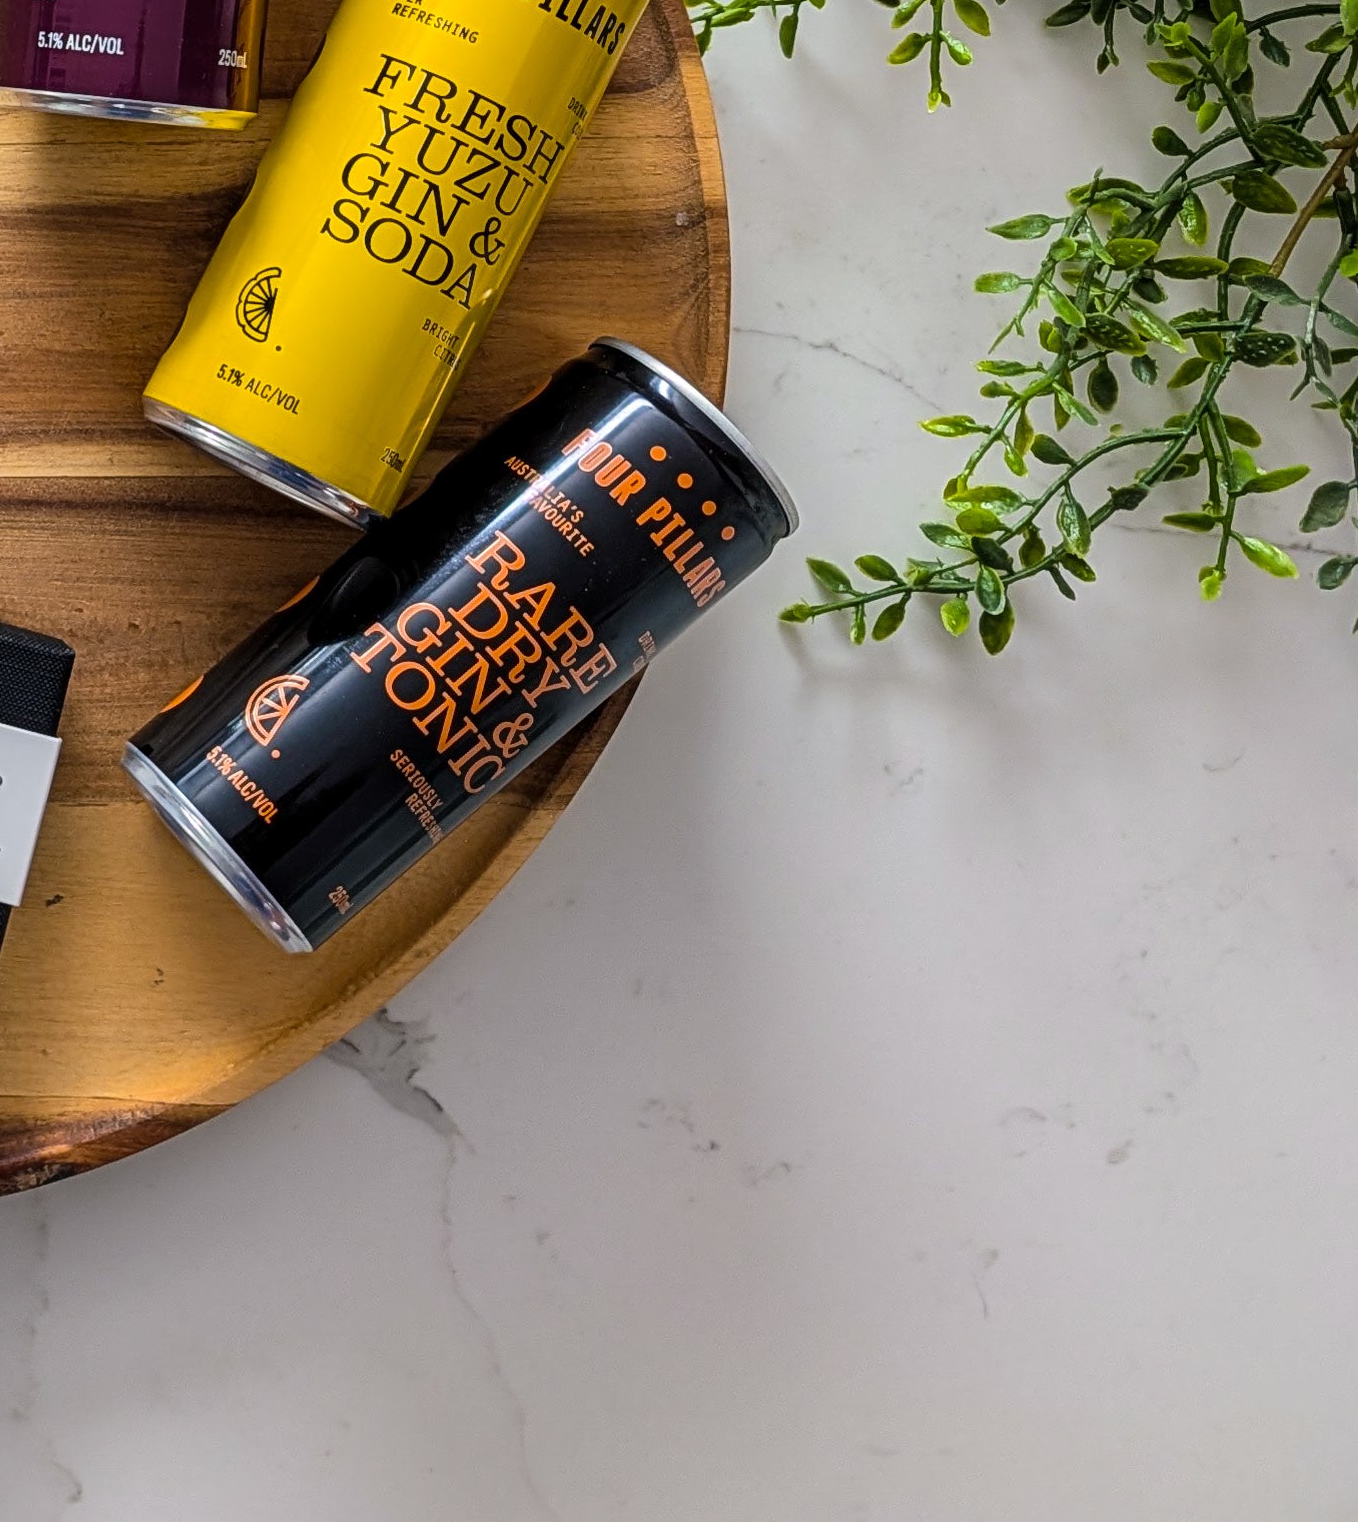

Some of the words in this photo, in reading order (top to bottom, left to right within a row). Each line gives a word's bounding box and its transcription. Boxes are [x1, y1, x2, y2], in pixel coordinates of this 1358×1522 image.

[38, 31, 63, 49] 5.1%
[66, 33, 125, 55] ALC/VOL
[392, 3, 479, 44] REFRESHING
[363, 54, 564, 184] FRESH
[370, 105, 533, 216] YUZU
[320, 199, 477, 309] SODA
[342, 153, 470, 237] GIN
[469, 217, 505, 266] &
[422, 318, 459, 348] BRIGHT
[216, 364, 243, 388] 5.1%
[244, 379, 300, 415] ALC/VOL
[561, 428, 646, 507] FOUR
[636, 497, 725, 607] PILLARS
[448, 582, 571, 709] DRY
[465, 530, 617, 694] RARE
[350, 622, 505, 793] TONIC
[397, 602, 512, 715] GIN
[493, 712, 534, 758] &
[206, 745, 237, 776] 5.1%
[227, 770, 278, 824] ALC/VOL
[390, 749, 443, 809] SERIOUSLY
